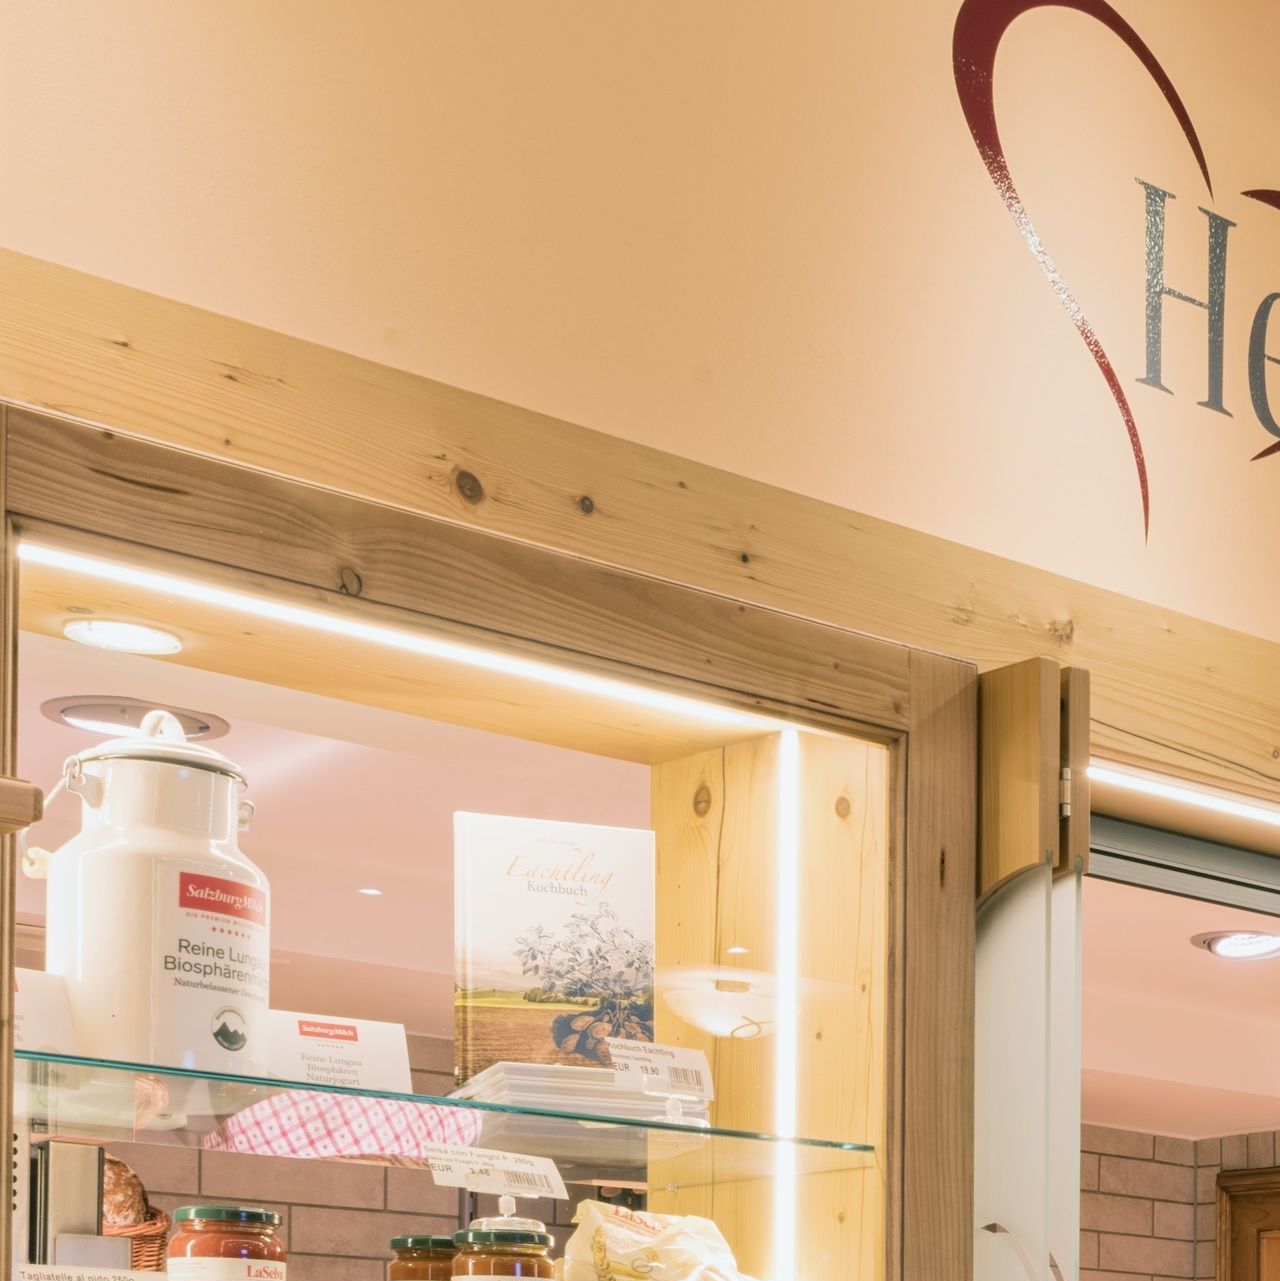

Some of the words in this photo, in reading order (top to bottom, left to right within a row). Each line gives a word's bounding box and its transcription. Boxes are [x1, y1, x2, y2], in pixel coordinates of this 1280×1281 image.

[527, 880, 588, 897] Kochbuch
[178, 938, 225, 959] Reine
[301, 1052, 327, 1064] Reine
[613, 1062, 630, 1072] EUR
[431, 1163, 454, 1173] EUR
